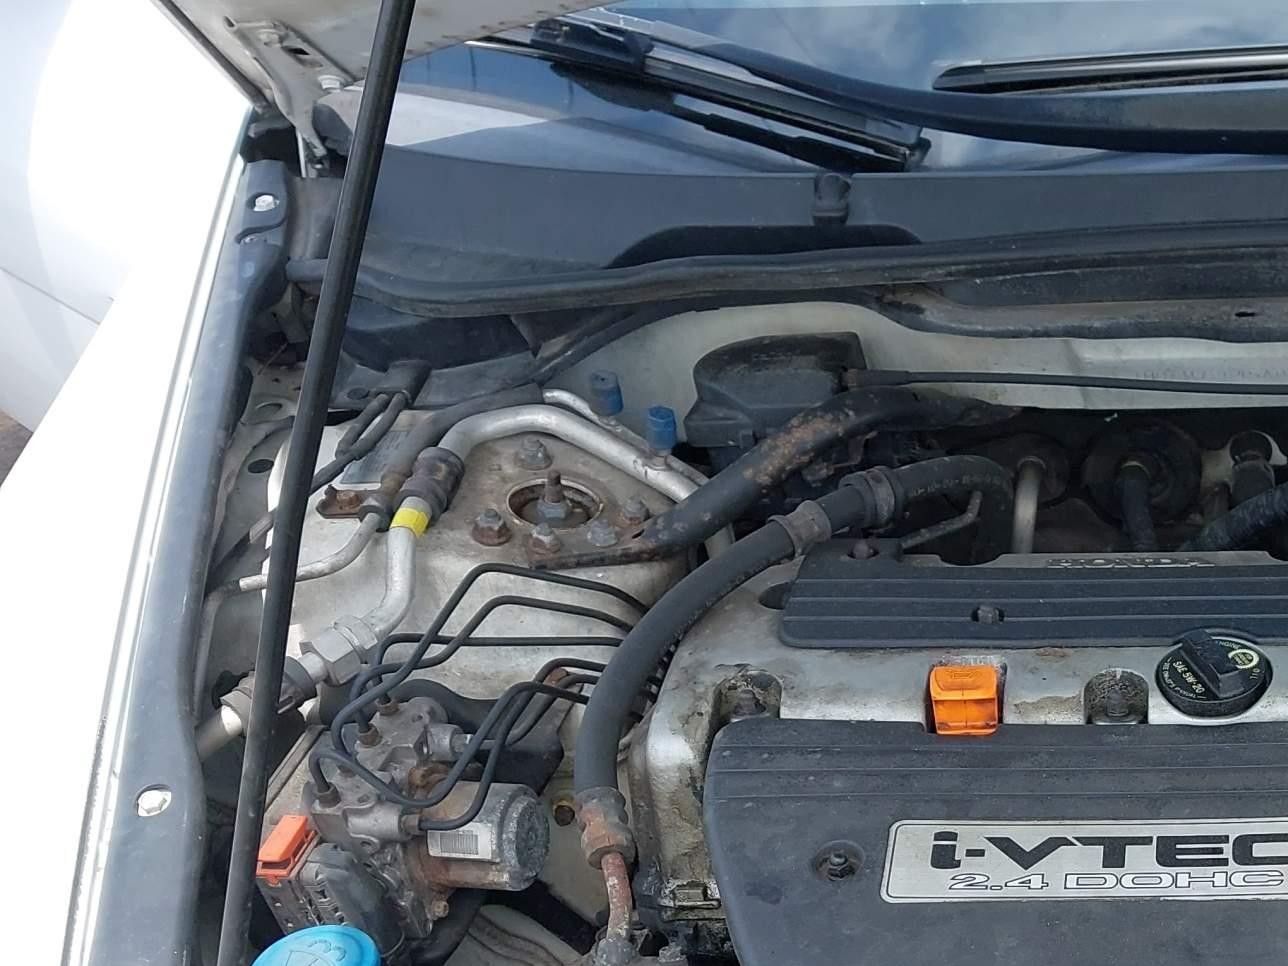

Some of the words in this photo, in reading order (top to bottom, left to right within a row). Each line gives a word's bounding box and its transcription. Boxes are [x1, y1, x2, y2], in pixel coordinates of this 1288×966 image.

[1173, 660, 1186, 673] SAE
[1182, 671, 1206, 694] 5W-20
[948, 872, 1049, 891] 2.4
[1063, 870, 1285, 890] DOHC
